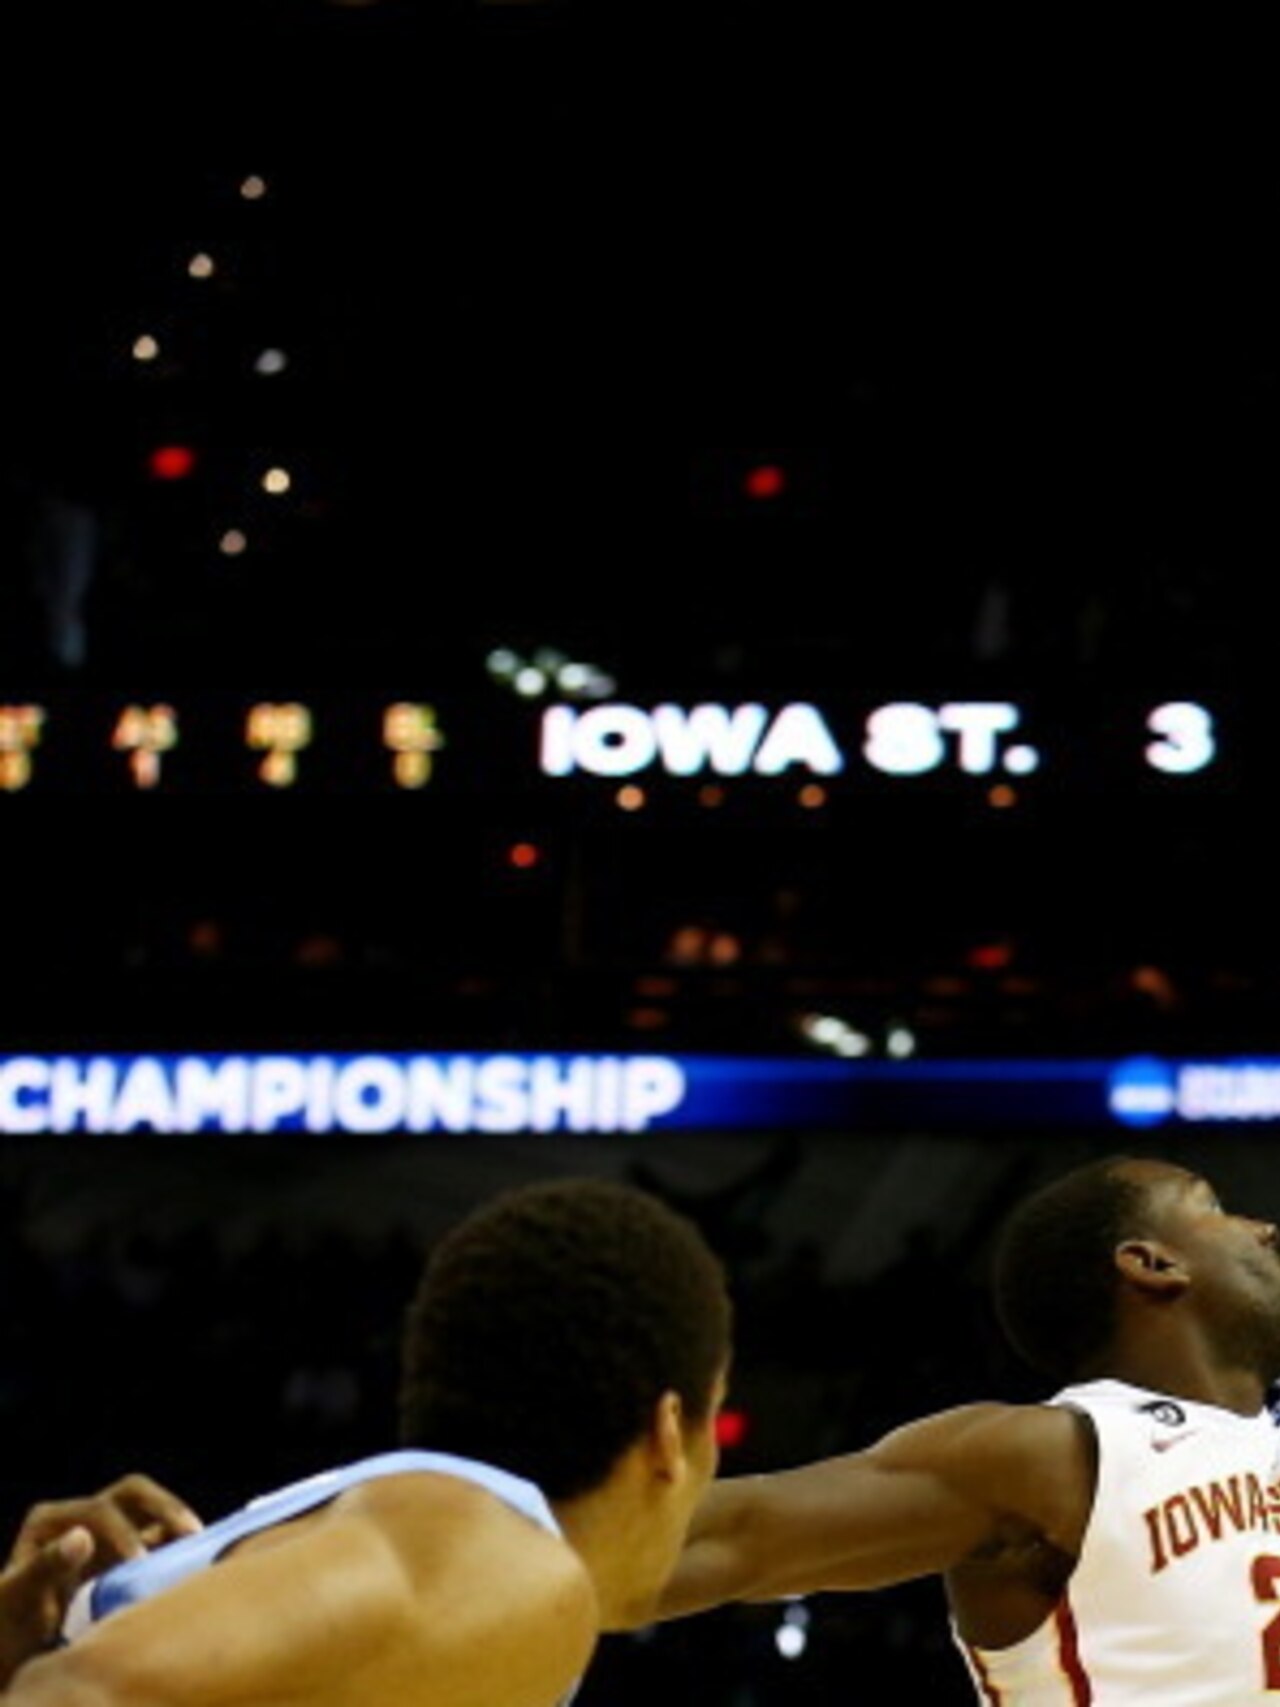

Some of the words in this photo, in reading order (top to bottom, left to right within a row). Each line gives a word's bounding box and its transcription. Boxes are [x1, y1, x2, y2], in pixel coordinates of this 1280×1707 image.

[541, 703, 843, 775] IOWA
[864, 703, 1038, 774] ST.
[1146, 702, 1215, 773] 3
[0, 1056, 684, 1133] CHAMPIONSHIP
[1141, 1471, 1268, 1575] IOWA
